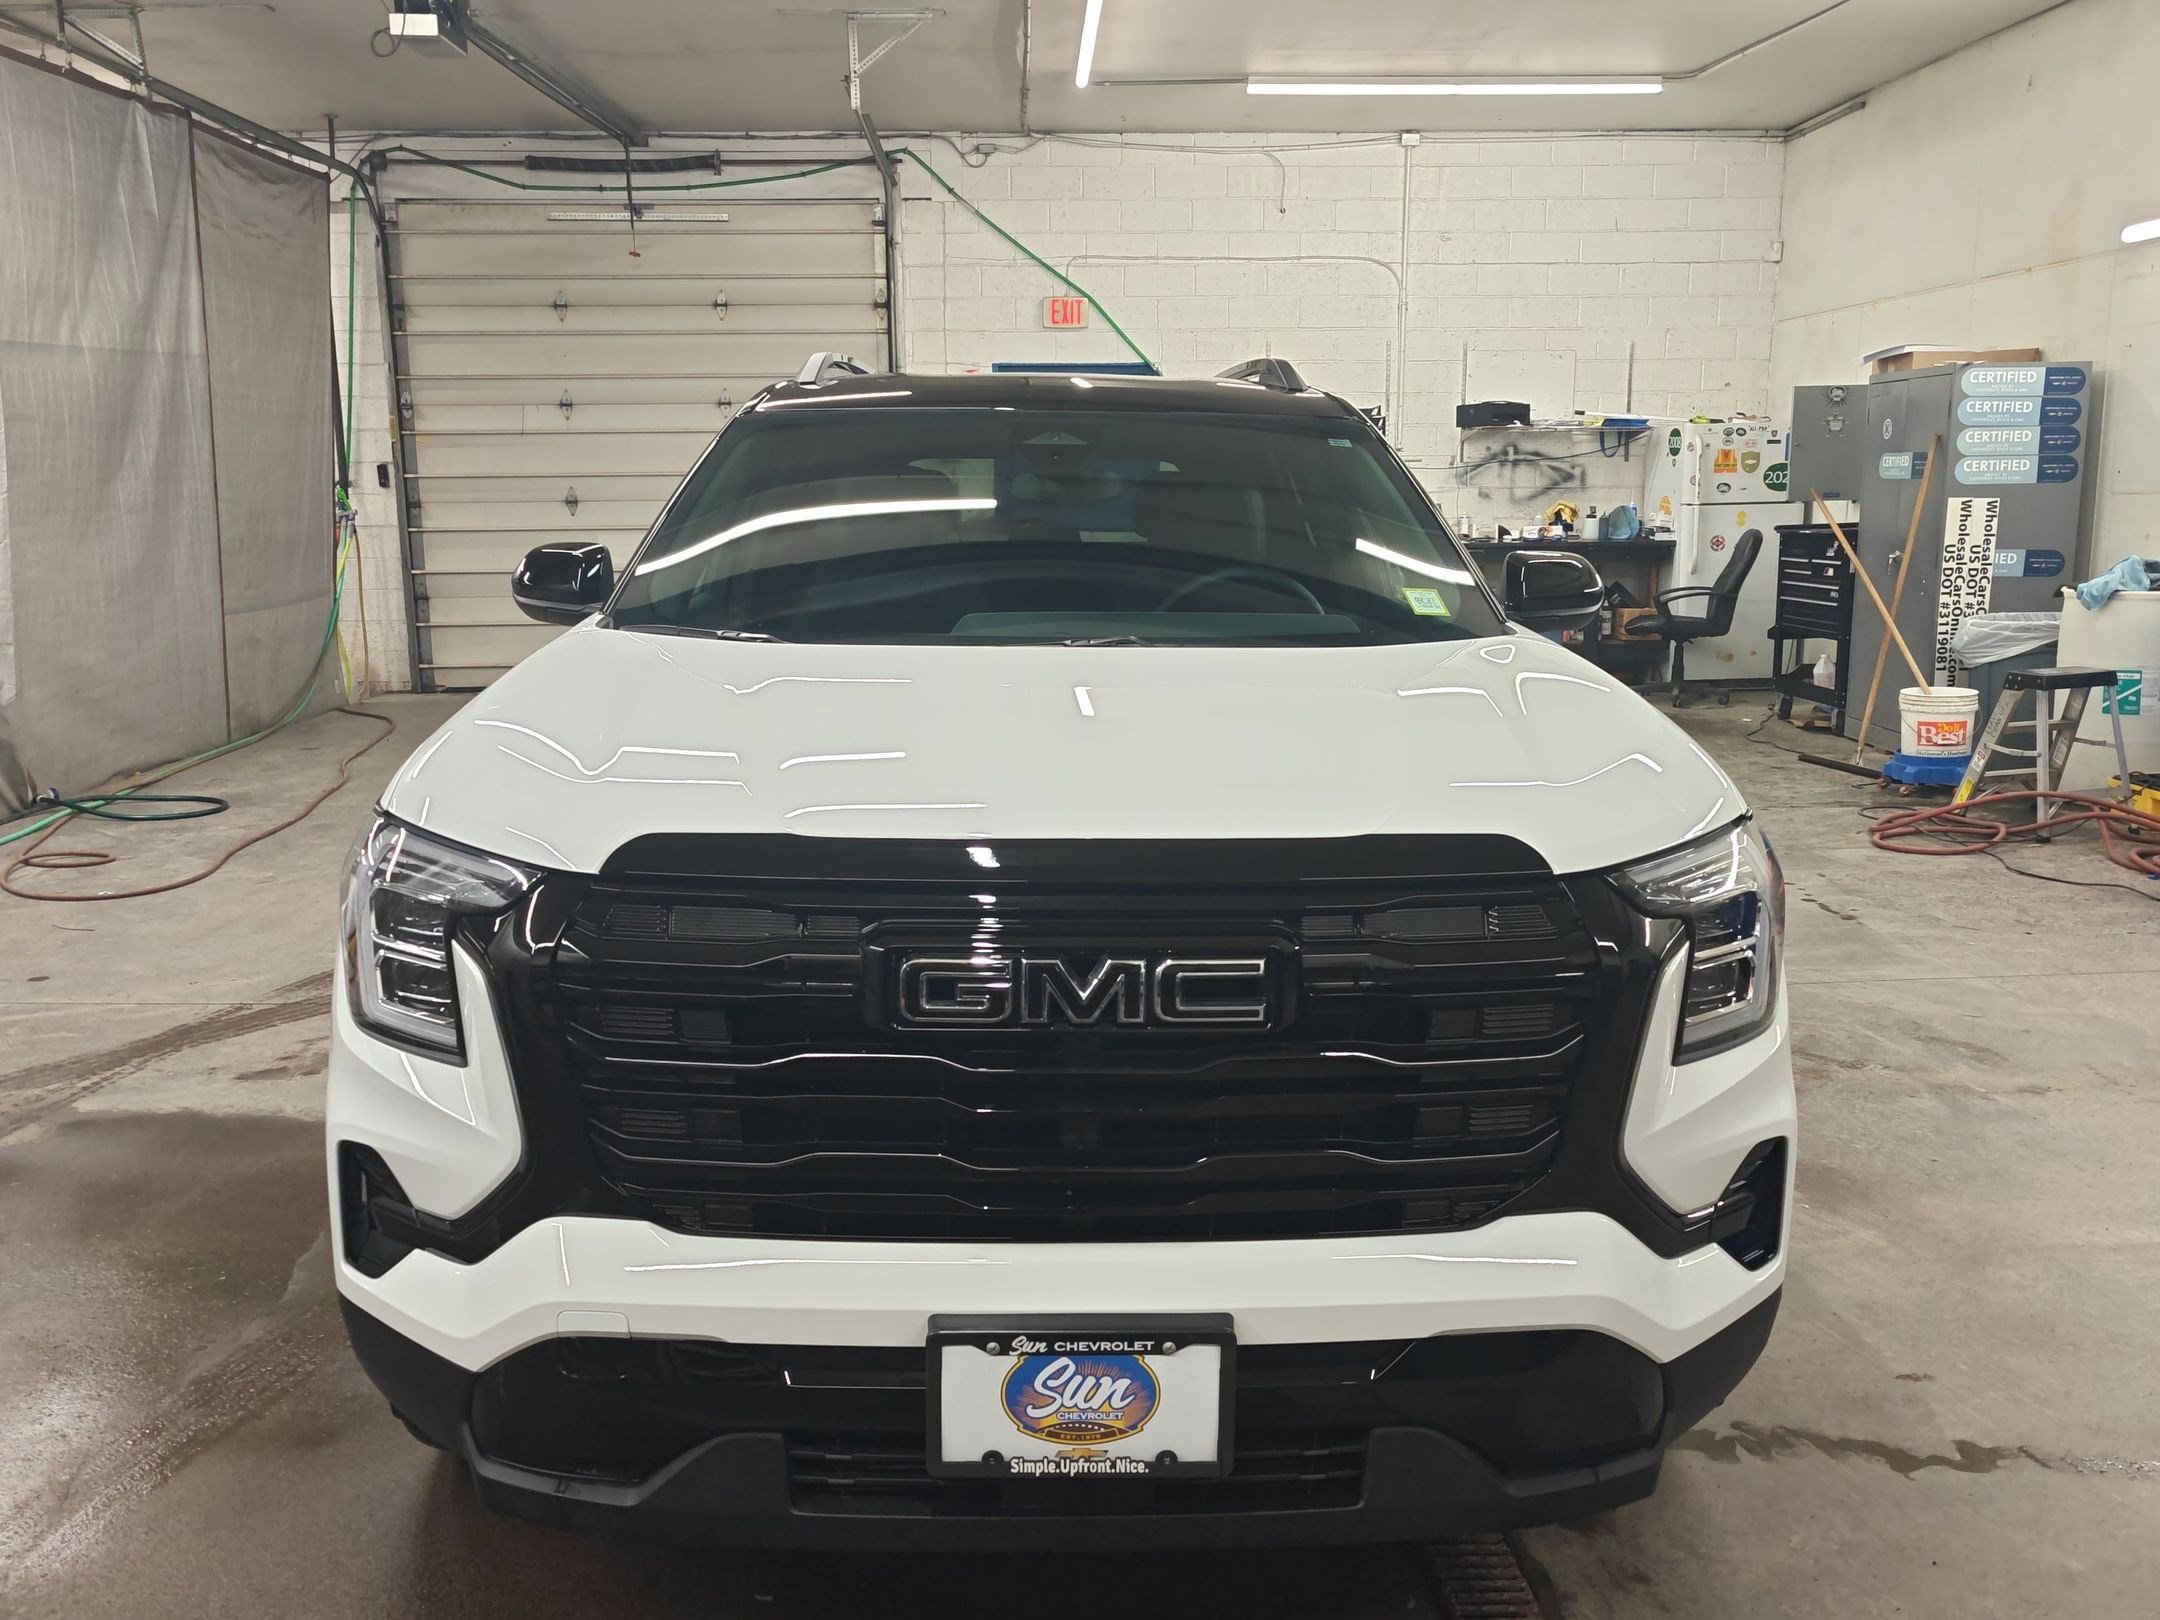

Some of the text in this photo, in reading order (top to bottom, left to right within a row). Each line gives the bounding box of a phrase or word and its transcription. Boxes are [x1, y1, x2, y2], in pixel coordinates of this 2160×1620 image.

[1052, 299, 1083, 324] EXIT
[1970, 371, 2037, 383] CERTIFIED
[1966, 401, 2033, 413] CERTIFIED
[1965, 430, 2032, 443] CERTIFIED
[1882, 456, 1909, 467] CERTIFIED
[1963, 459, 2030, 472] CERTIFIED
[1969, 544, 1981, 564] US
[1965, 567, 1979, 598] DOT
[1936, 544, 1956, 671] US DOT #3119081
[1919, 725, 1966, 745] Best
[900, 957, 1267, 1025] GMC
[1009, 1335, 1155, 1356] Sun CHEVROLET
[1026, 1356, 1136, 1419] Sun
[1056, 1411, 1124, 1421] CHEVROLET
[1010, 1456, 1149, 1477] Simple.Upfront.Nice.
